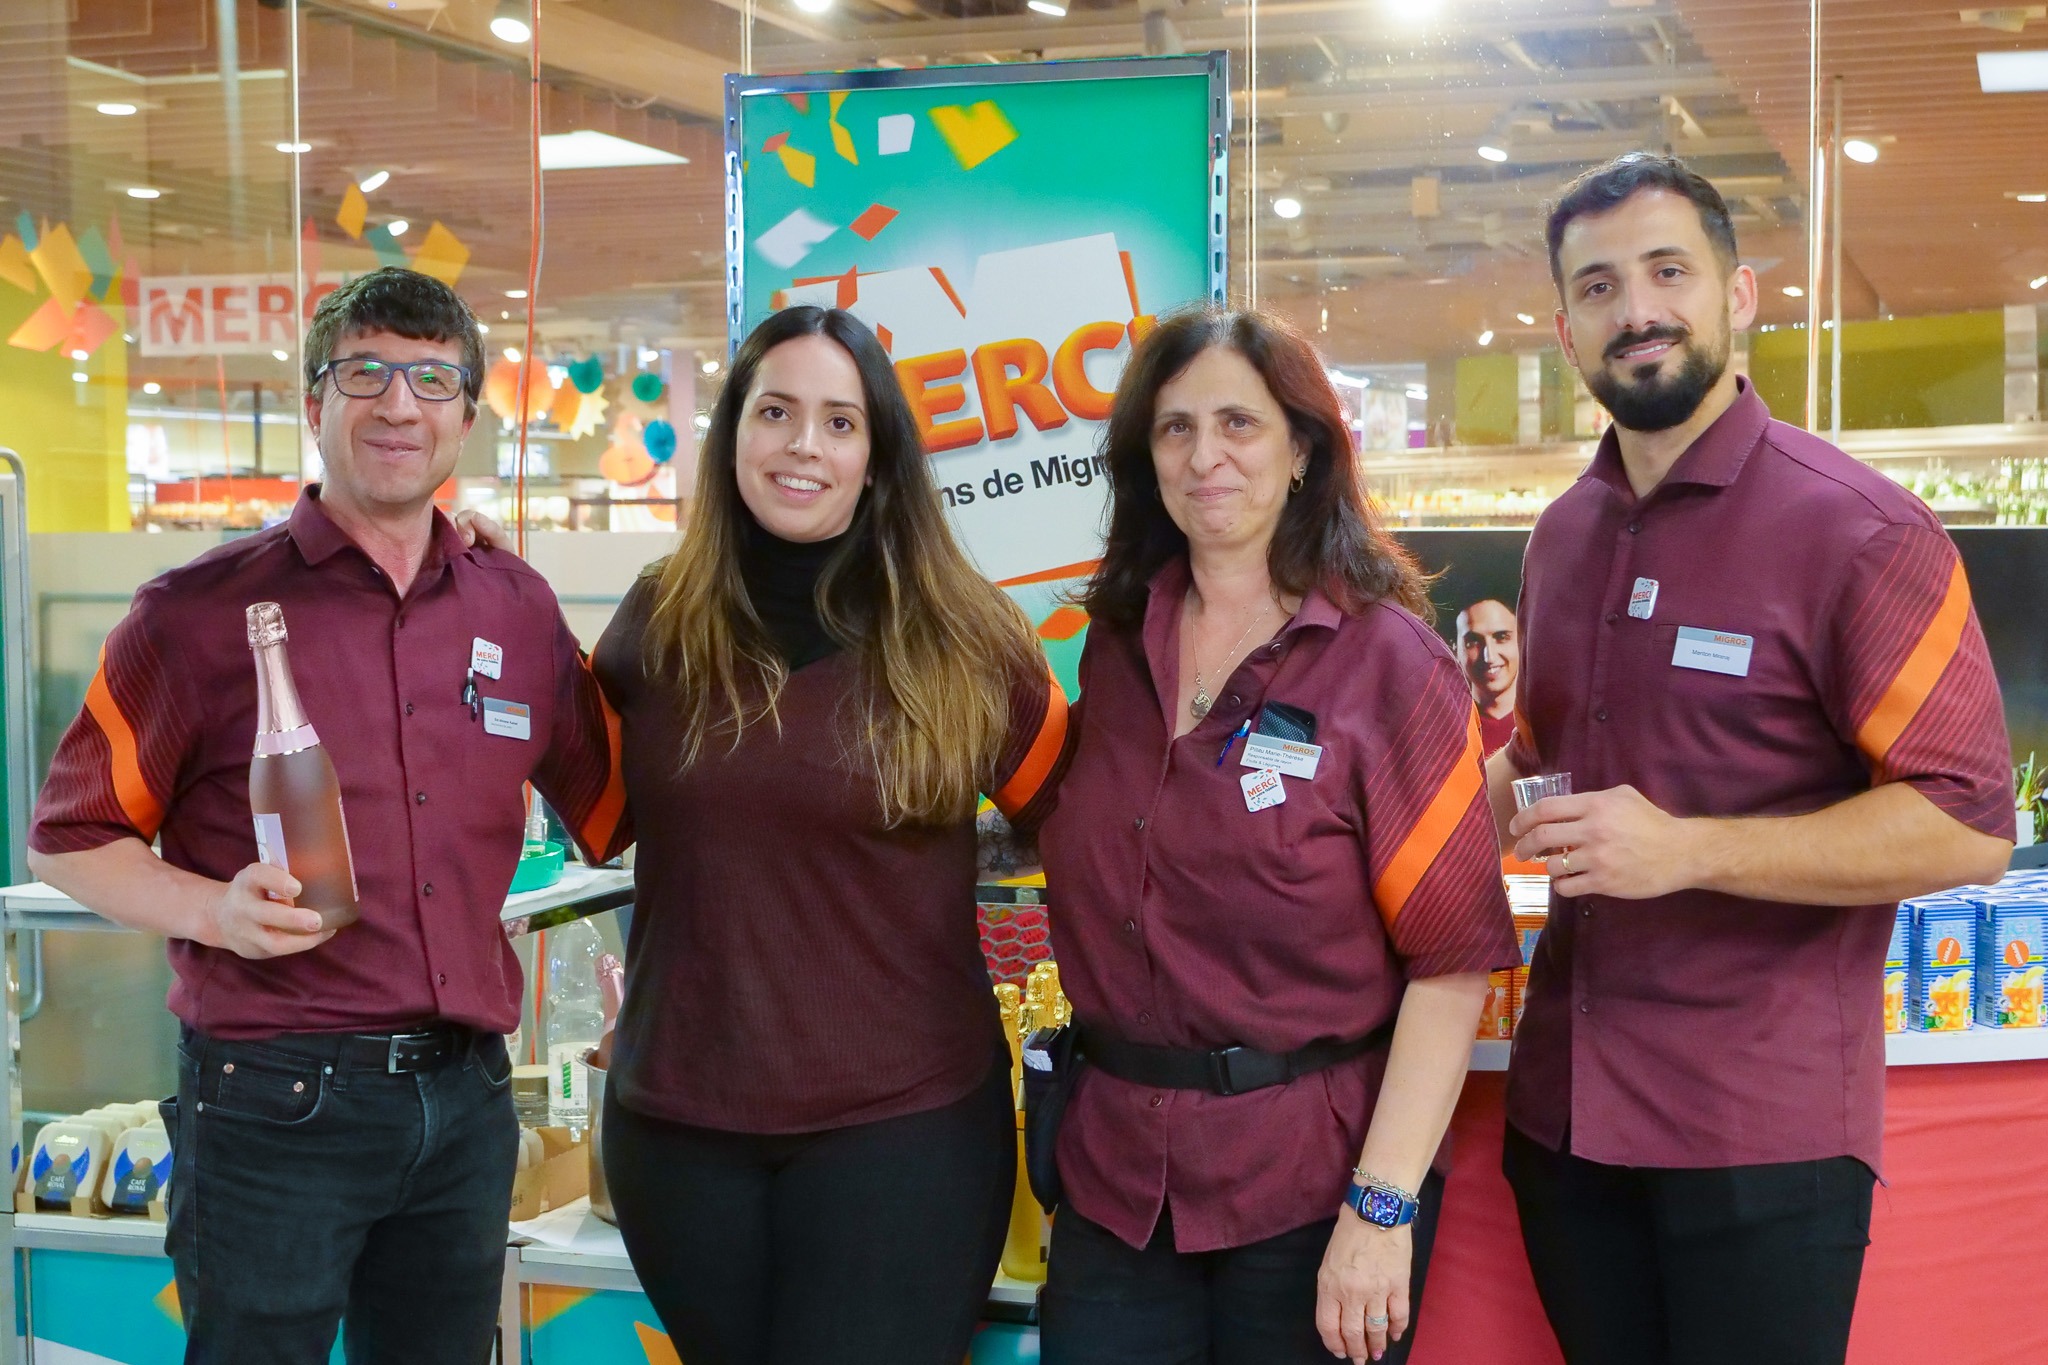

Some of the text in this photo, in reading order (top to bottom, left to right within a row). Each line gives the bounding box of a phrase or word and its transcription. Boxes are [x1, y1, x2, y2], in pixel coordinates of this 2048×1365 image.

[149, 283, 342, 343] MERC
[894, 315, 1158, 453] ERC
[941, 454, 1103, 508] ns de Migr
[1632, 590, 1652, 600] MERCI
[1714, 634, 1747, 646] MIGROS
[476, 651, 499, 661] MERCI
[1282, 744, 1315, 756] MIGROS
[1247, 776, 1277, 797] MERCI
